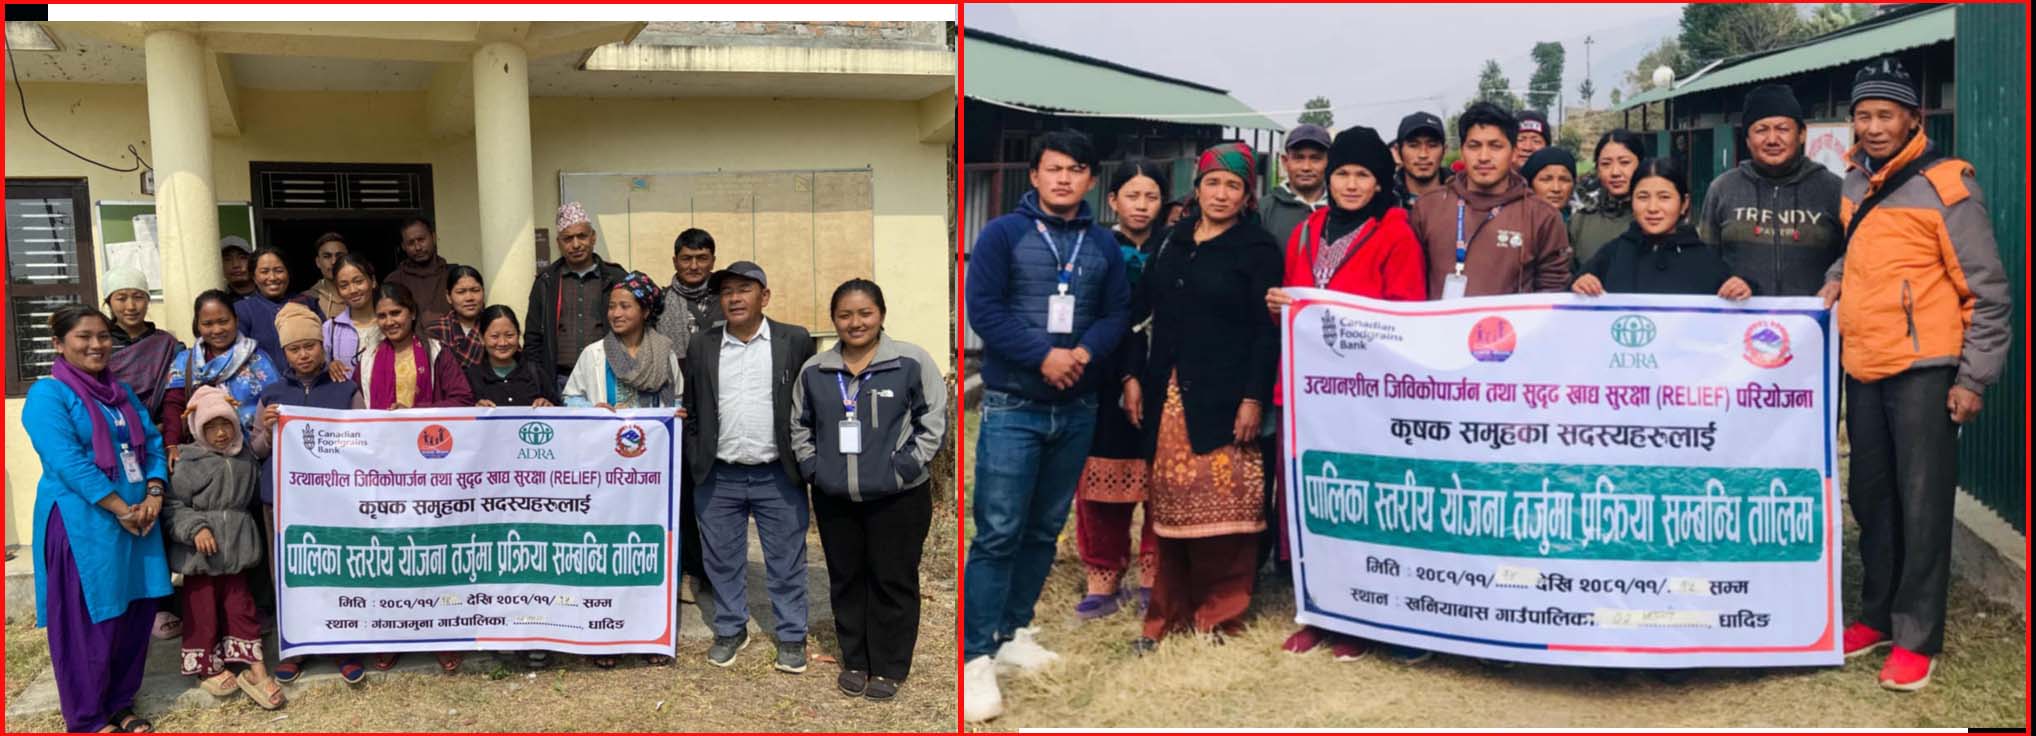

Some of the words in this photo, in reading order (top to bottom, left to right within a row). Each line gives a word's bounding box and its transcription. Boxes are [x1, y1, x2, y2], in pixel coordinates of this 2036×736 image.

[1339, 317, 1396, 332] Canadian
[1339, 329, 1403, 343] Foodgrains
[1339, 340, 1367, 351] Bank
[1608, 352, 1659, 369] ADRA
[1303, 372, 1379, 398] उत्थानशील
[1383, 373, 1480, 403] जिविकोपार्जन
[1485, 382, 1516, 403] तथा
[1565, 384, 1600, 405] खाद्य
[1604, 384, 1650, 410] सुरक्षा
[1656, 385, 1731, 412] (RELIEF)
[1735, 382, 1813, 409] परियोजना
[317, 429, 361, 438] Canadian
[1390, 418, 1452, 446] कृषक
[1459, 421, 1549, 449] समुहका
[317, 437, 368, 448] Foodgrains
[317, 446, 340, 454] Bank
[517, 448, 555, 460] ADRA
[289, 469, 350, 488] उत्थानशील
[354, 469, 426, 488] जिविकोपार्जन
[430, 472, 452, 487] तथा
[486, 471, 510, 486] खाद्य
[514, 470, 546, 487] सुरक्षा
[550, 470, 601, 488] (RELIEF)
[605, 467, 661, 486] परियोजना
[358, 500, 407, 519] कृषक
[412, 498, 476, 518] समुहका
[1304, 460, 1369, 526] पालिका
[1374, 469, 1435, 533] स्तरीय
[1439, 471, 1507, 538] योजना
[1512, 477, 1575, 555] तर्जुमा
[1580, 474, 1655, 547] प्रक्रिया
[1661, 477, 1743, 547] सम्बन्धि
[1747, 477, 1815, 546] तालिम
[287, 531, 342, 577] पालिका
[346, 535, 394, 579] स्तरीय
[398, 535, 447, 577] योजना
[451, 533, 493, 583] तर्जुमा
[497, 529, 548, 576] प्रक्रिया
[552, 531, 608, 576] सम्बन्धि
[612, 531, 659, 576] तालिम
[1365, 556, 1400, 577] मिति
[1709, 579, 1749, 596] सम्म
[338, 595, 367, 609] मिति
[467, 592, 493, 606] देखि
[583, 598, 612, 609] सम्म
[1350, 587, 1388, 606] स्थान
[1404, 596, 1489, 621] खनियाबास
[1719, 609, 1771, 629] धादिङ
[325, 619, 359, 629] स्थान
[371, 618, 433, 631] गंगाजमुना
